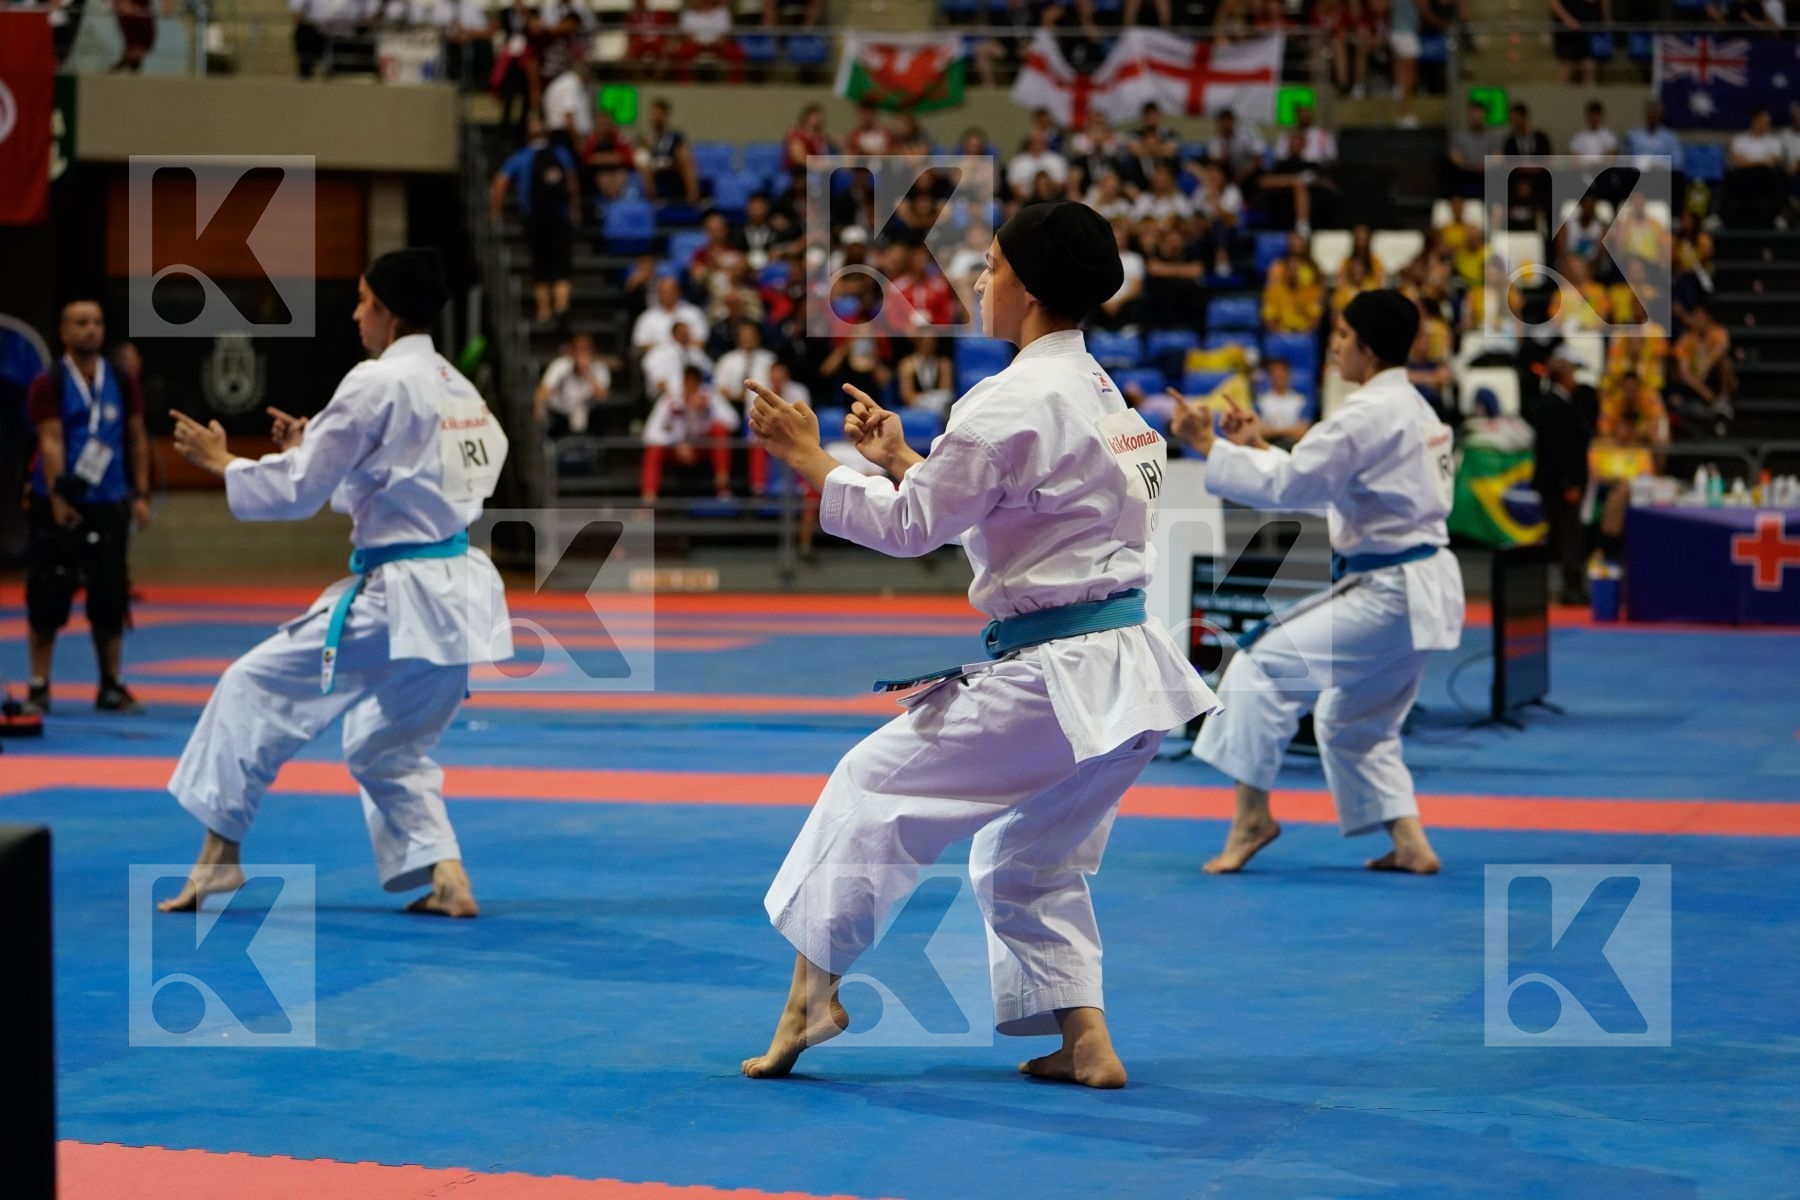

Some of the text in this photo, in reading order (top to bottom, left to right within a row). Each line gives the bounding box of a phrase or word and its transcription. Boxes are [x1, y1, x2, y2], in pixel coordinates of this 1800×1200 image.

[459, 438, 488, 468] IRI
[1108, 430, 1160, 455] kikkoman
[1136, 459, 1163, 499] IRI
